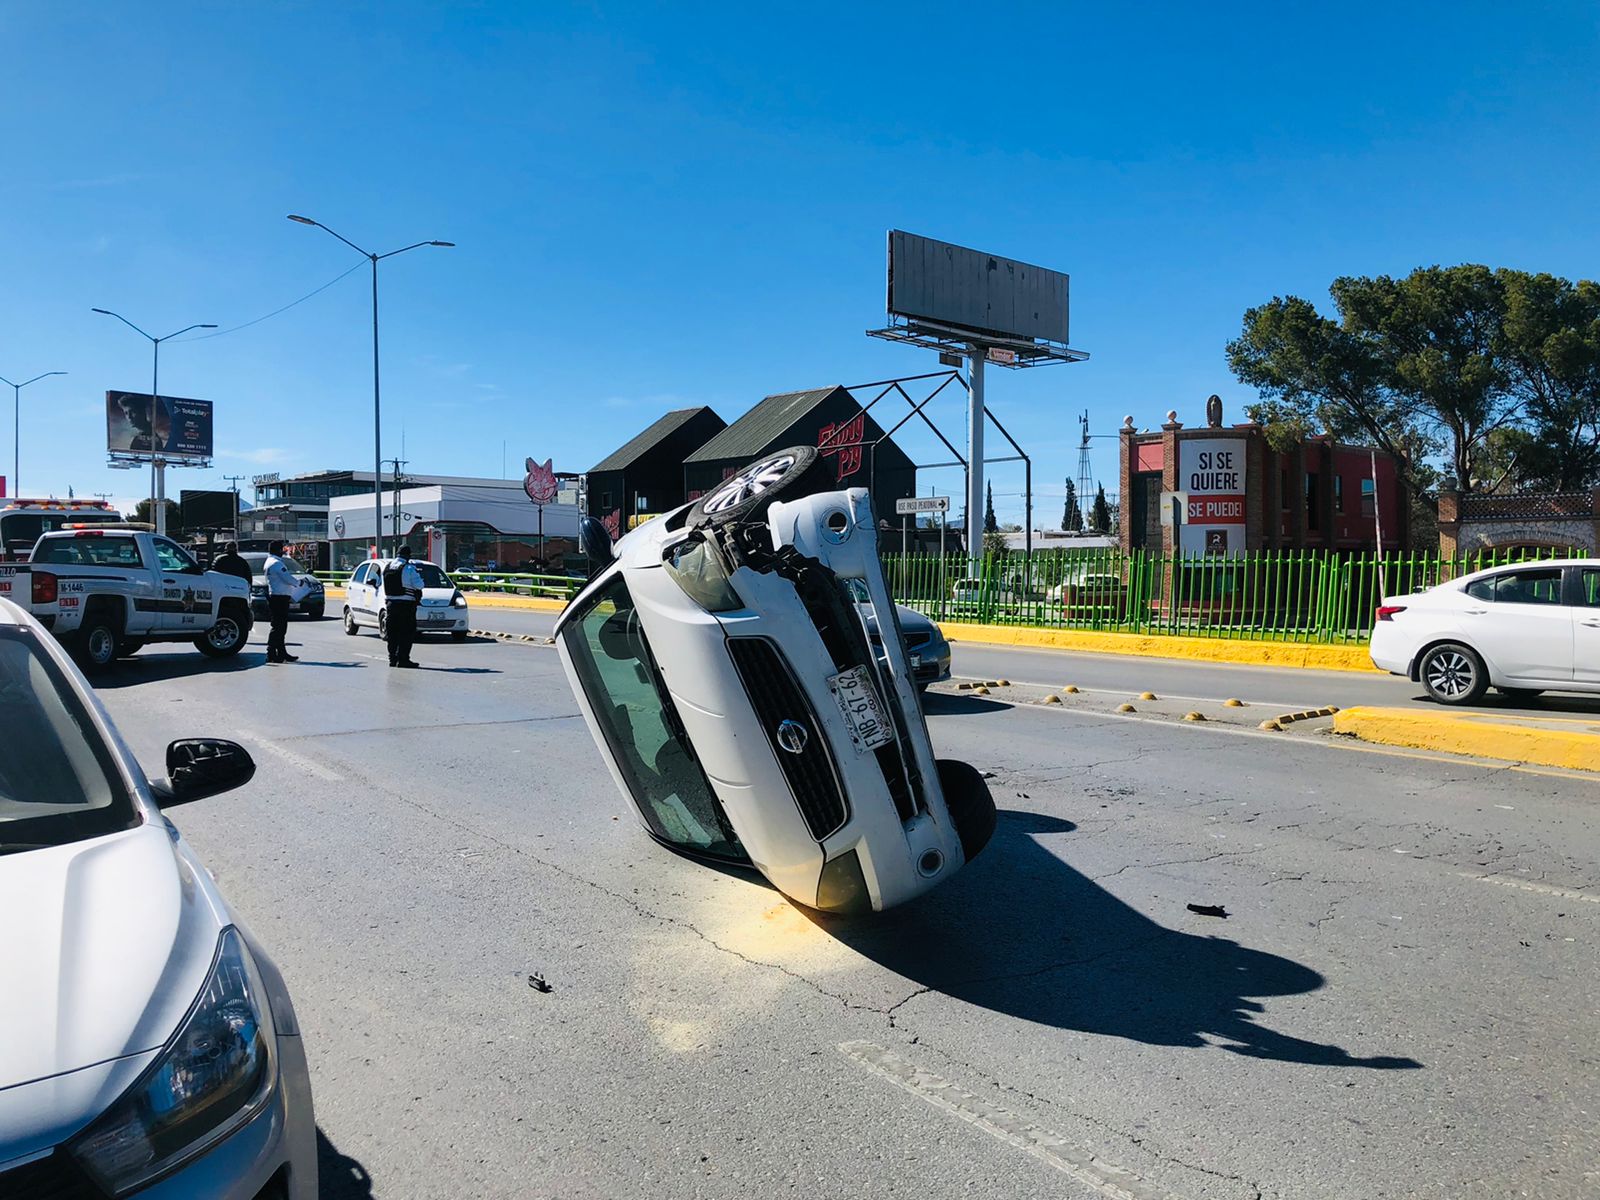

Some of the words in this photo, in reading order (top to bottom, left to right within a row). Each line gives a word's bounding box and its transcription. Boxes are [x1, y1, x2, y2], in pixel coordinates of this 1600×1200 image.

[181, 407, 208, 417] Totalplay
[1199, 452, 1212, 470] SI
[1217, 452, 1233, 470] SE
[1191, 472, 1239, 491] QUIERE
[907, 501, 917, 510] PASO
[1188, 502, 1203, 517] SE
[1206, 502, 1243, 517] PUEDE!
